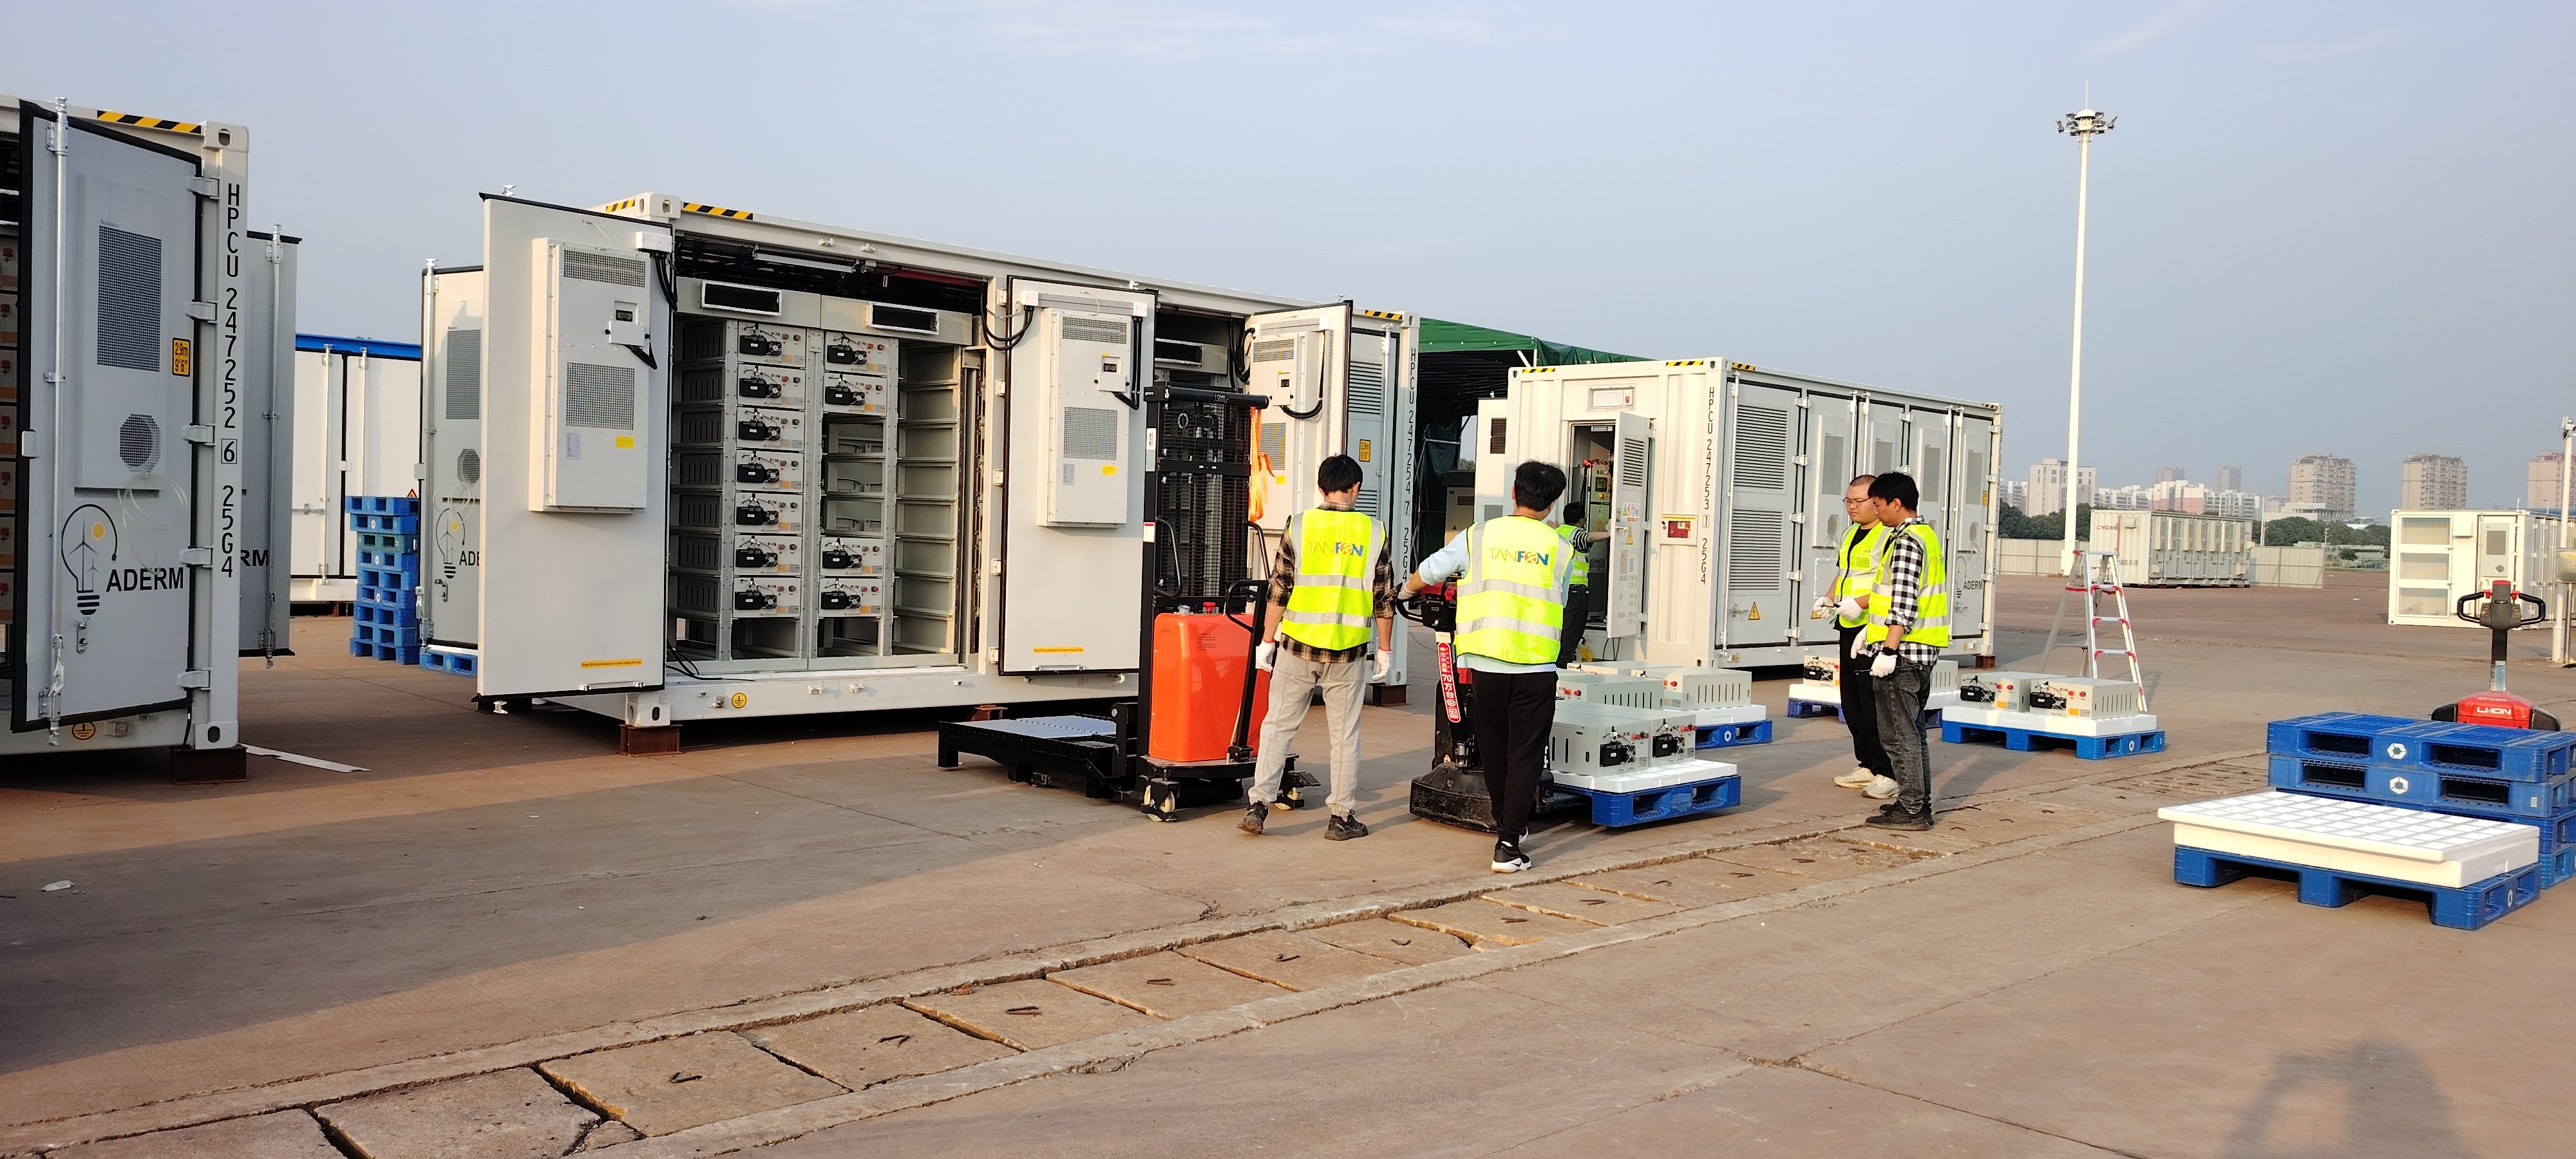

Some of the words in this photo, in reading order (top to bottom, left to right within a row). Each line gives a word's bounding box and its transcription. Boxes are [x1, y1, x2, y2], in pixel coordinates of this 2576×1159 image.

[227, 183, 240, 278] HPCU
[224, 287, 238, 429] 247252
[223, 440, 235, 462] 6
[1405, 410, 1414, 494] 247254
[1704, 438, 1712, 510] 247253
[221, 485, 234, 578] 25G4
[1306, 541, 1364, 557] TANFON
[106, 567, 184, 592] ADERM
[1488, 548, 1549, 566] TANFON
[1962, 580, 1983, 590] ADERM
